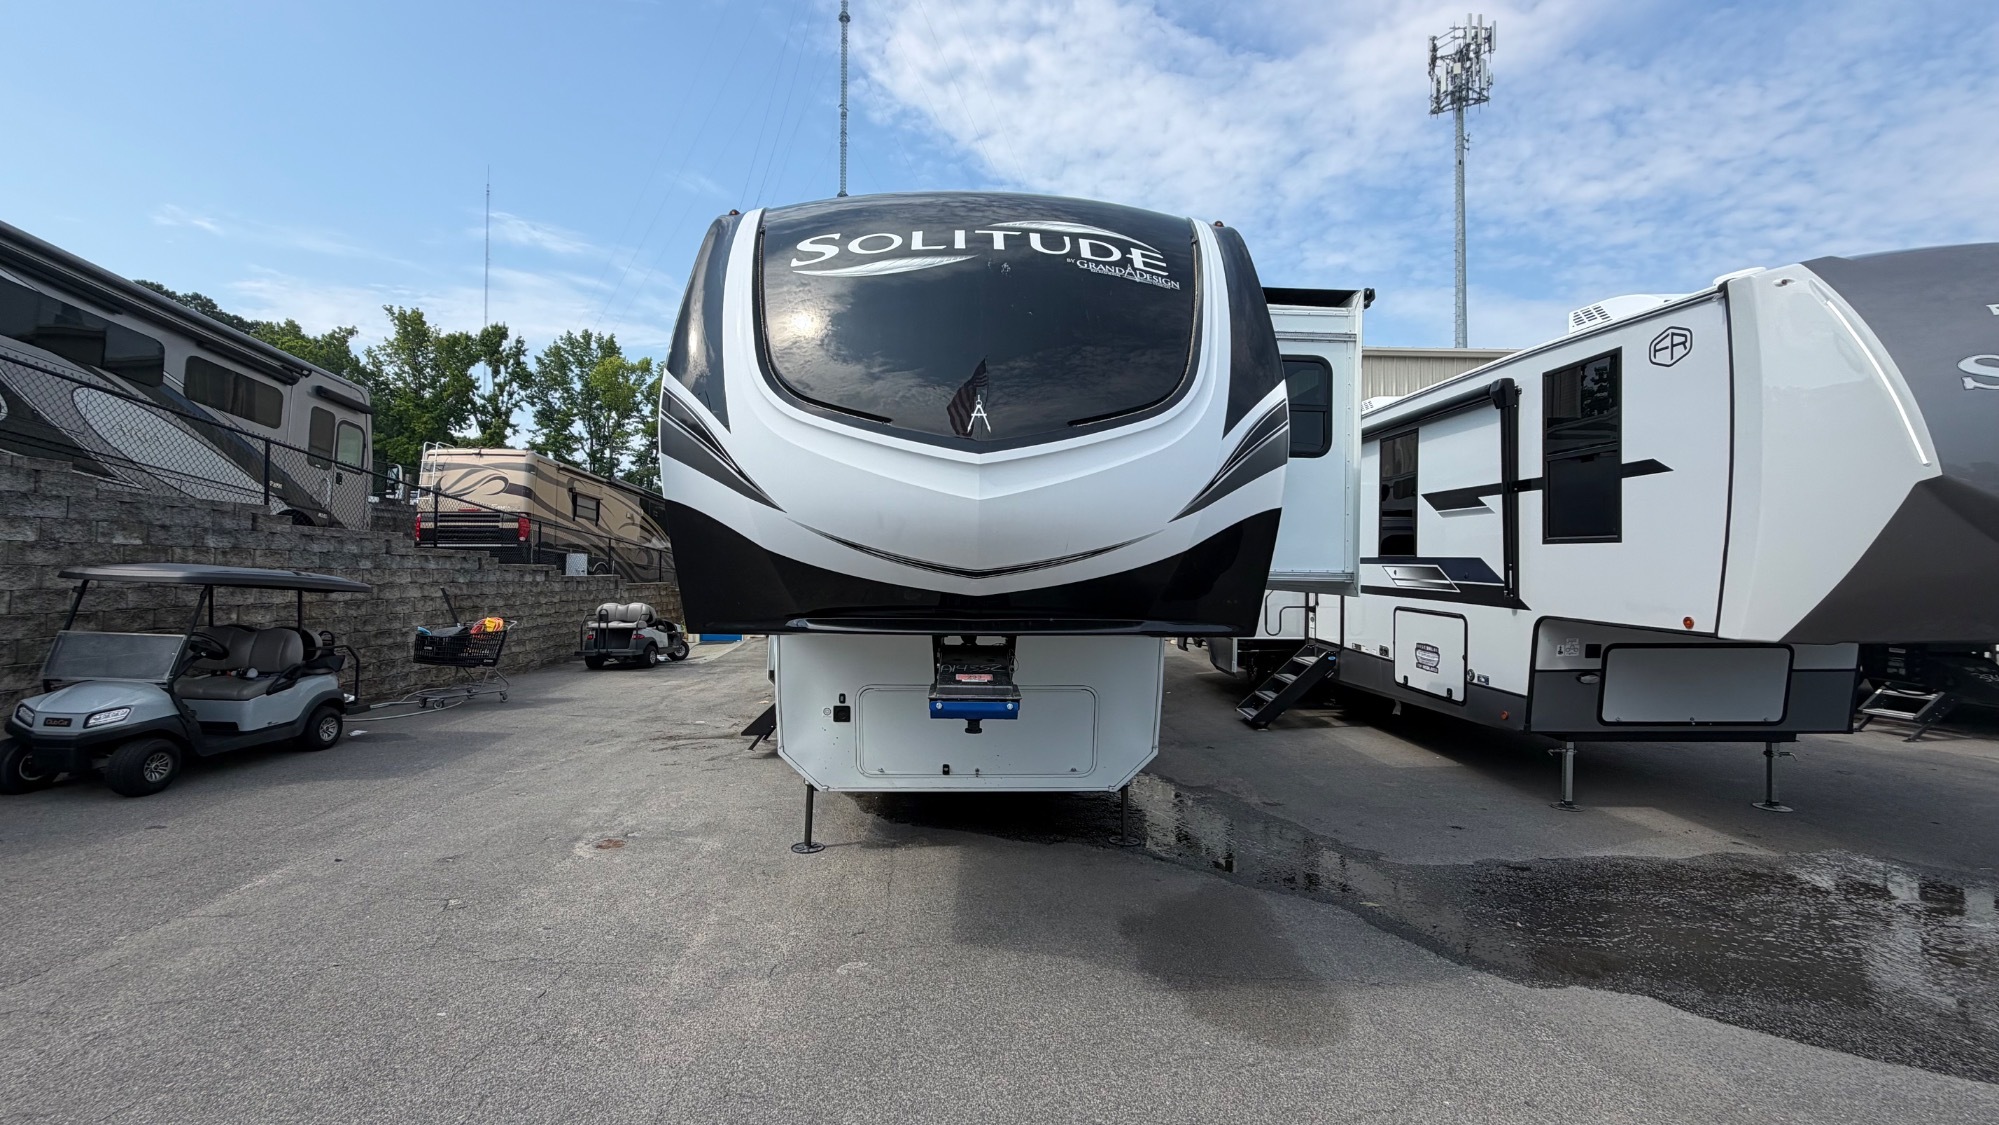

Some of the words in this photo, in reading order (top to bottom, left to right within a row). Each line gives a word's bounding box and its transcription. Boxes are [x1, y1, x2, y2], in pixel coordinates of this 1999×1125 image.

[789, 229, 1169, 276] SOLITUDE
[1076, 259, 1126, 278] GRAND
[1136, 270, 1180, 290] DESIGN
[1653, 331, 1688, 361] FR
